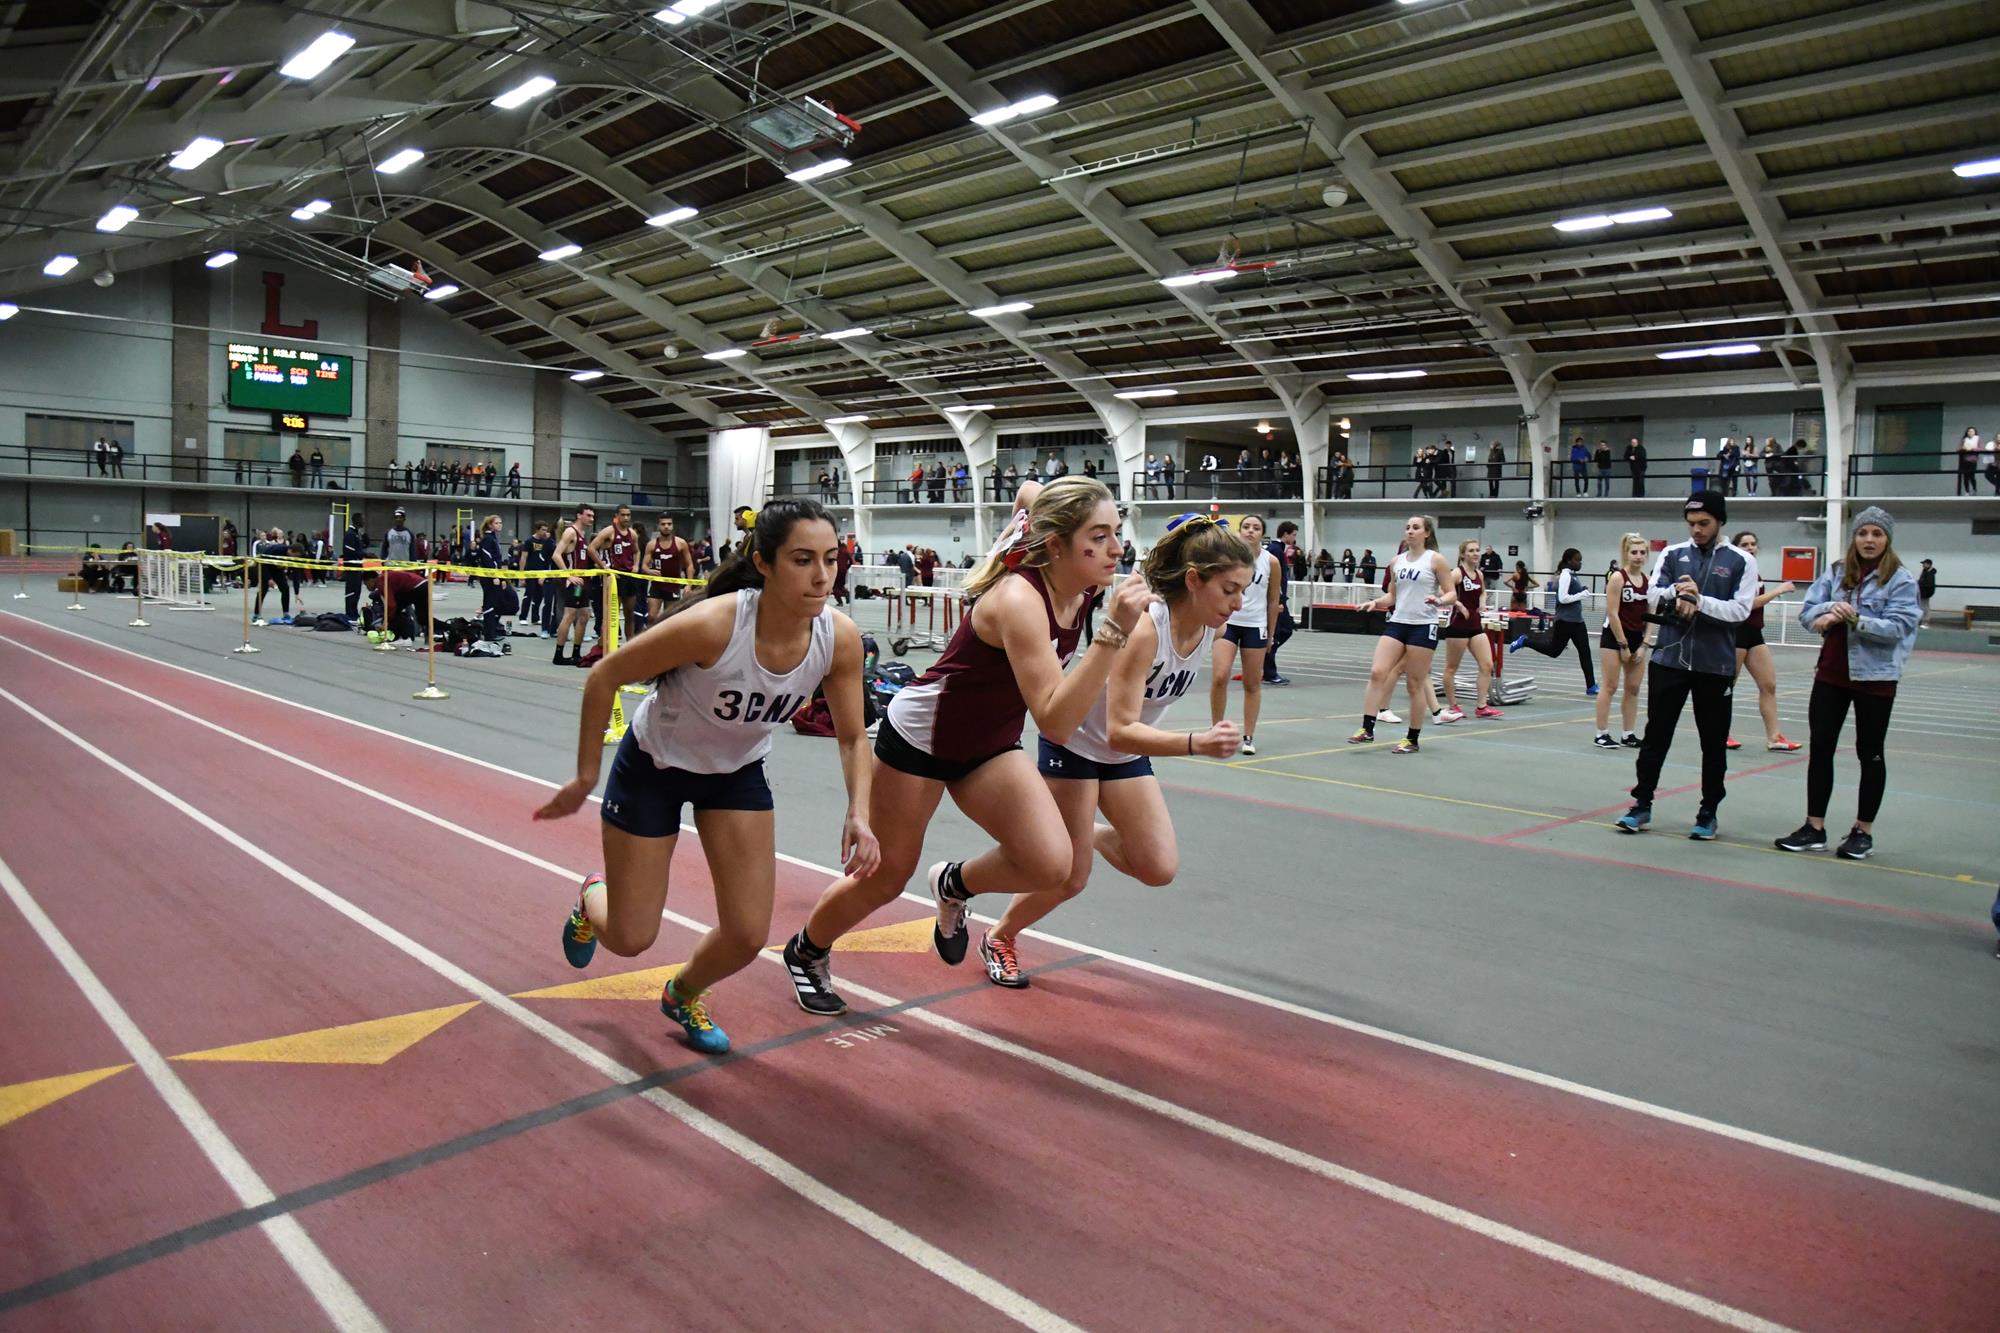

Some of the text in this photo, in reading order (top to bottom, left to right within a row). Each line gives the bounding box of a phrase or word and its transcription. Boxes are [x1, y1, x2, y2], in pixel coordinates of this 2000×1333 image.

[261, 271, 318, 340] L
[254, 364, 278, 373] NAME
[316, 370, 337, 379] TIME
[1398, 568, 1420, 581] CNJ
[1623, 588, 1631, 600] 3
[713, 690, 743, 721] 3
[824, 1023, 900, 1049] MILE
